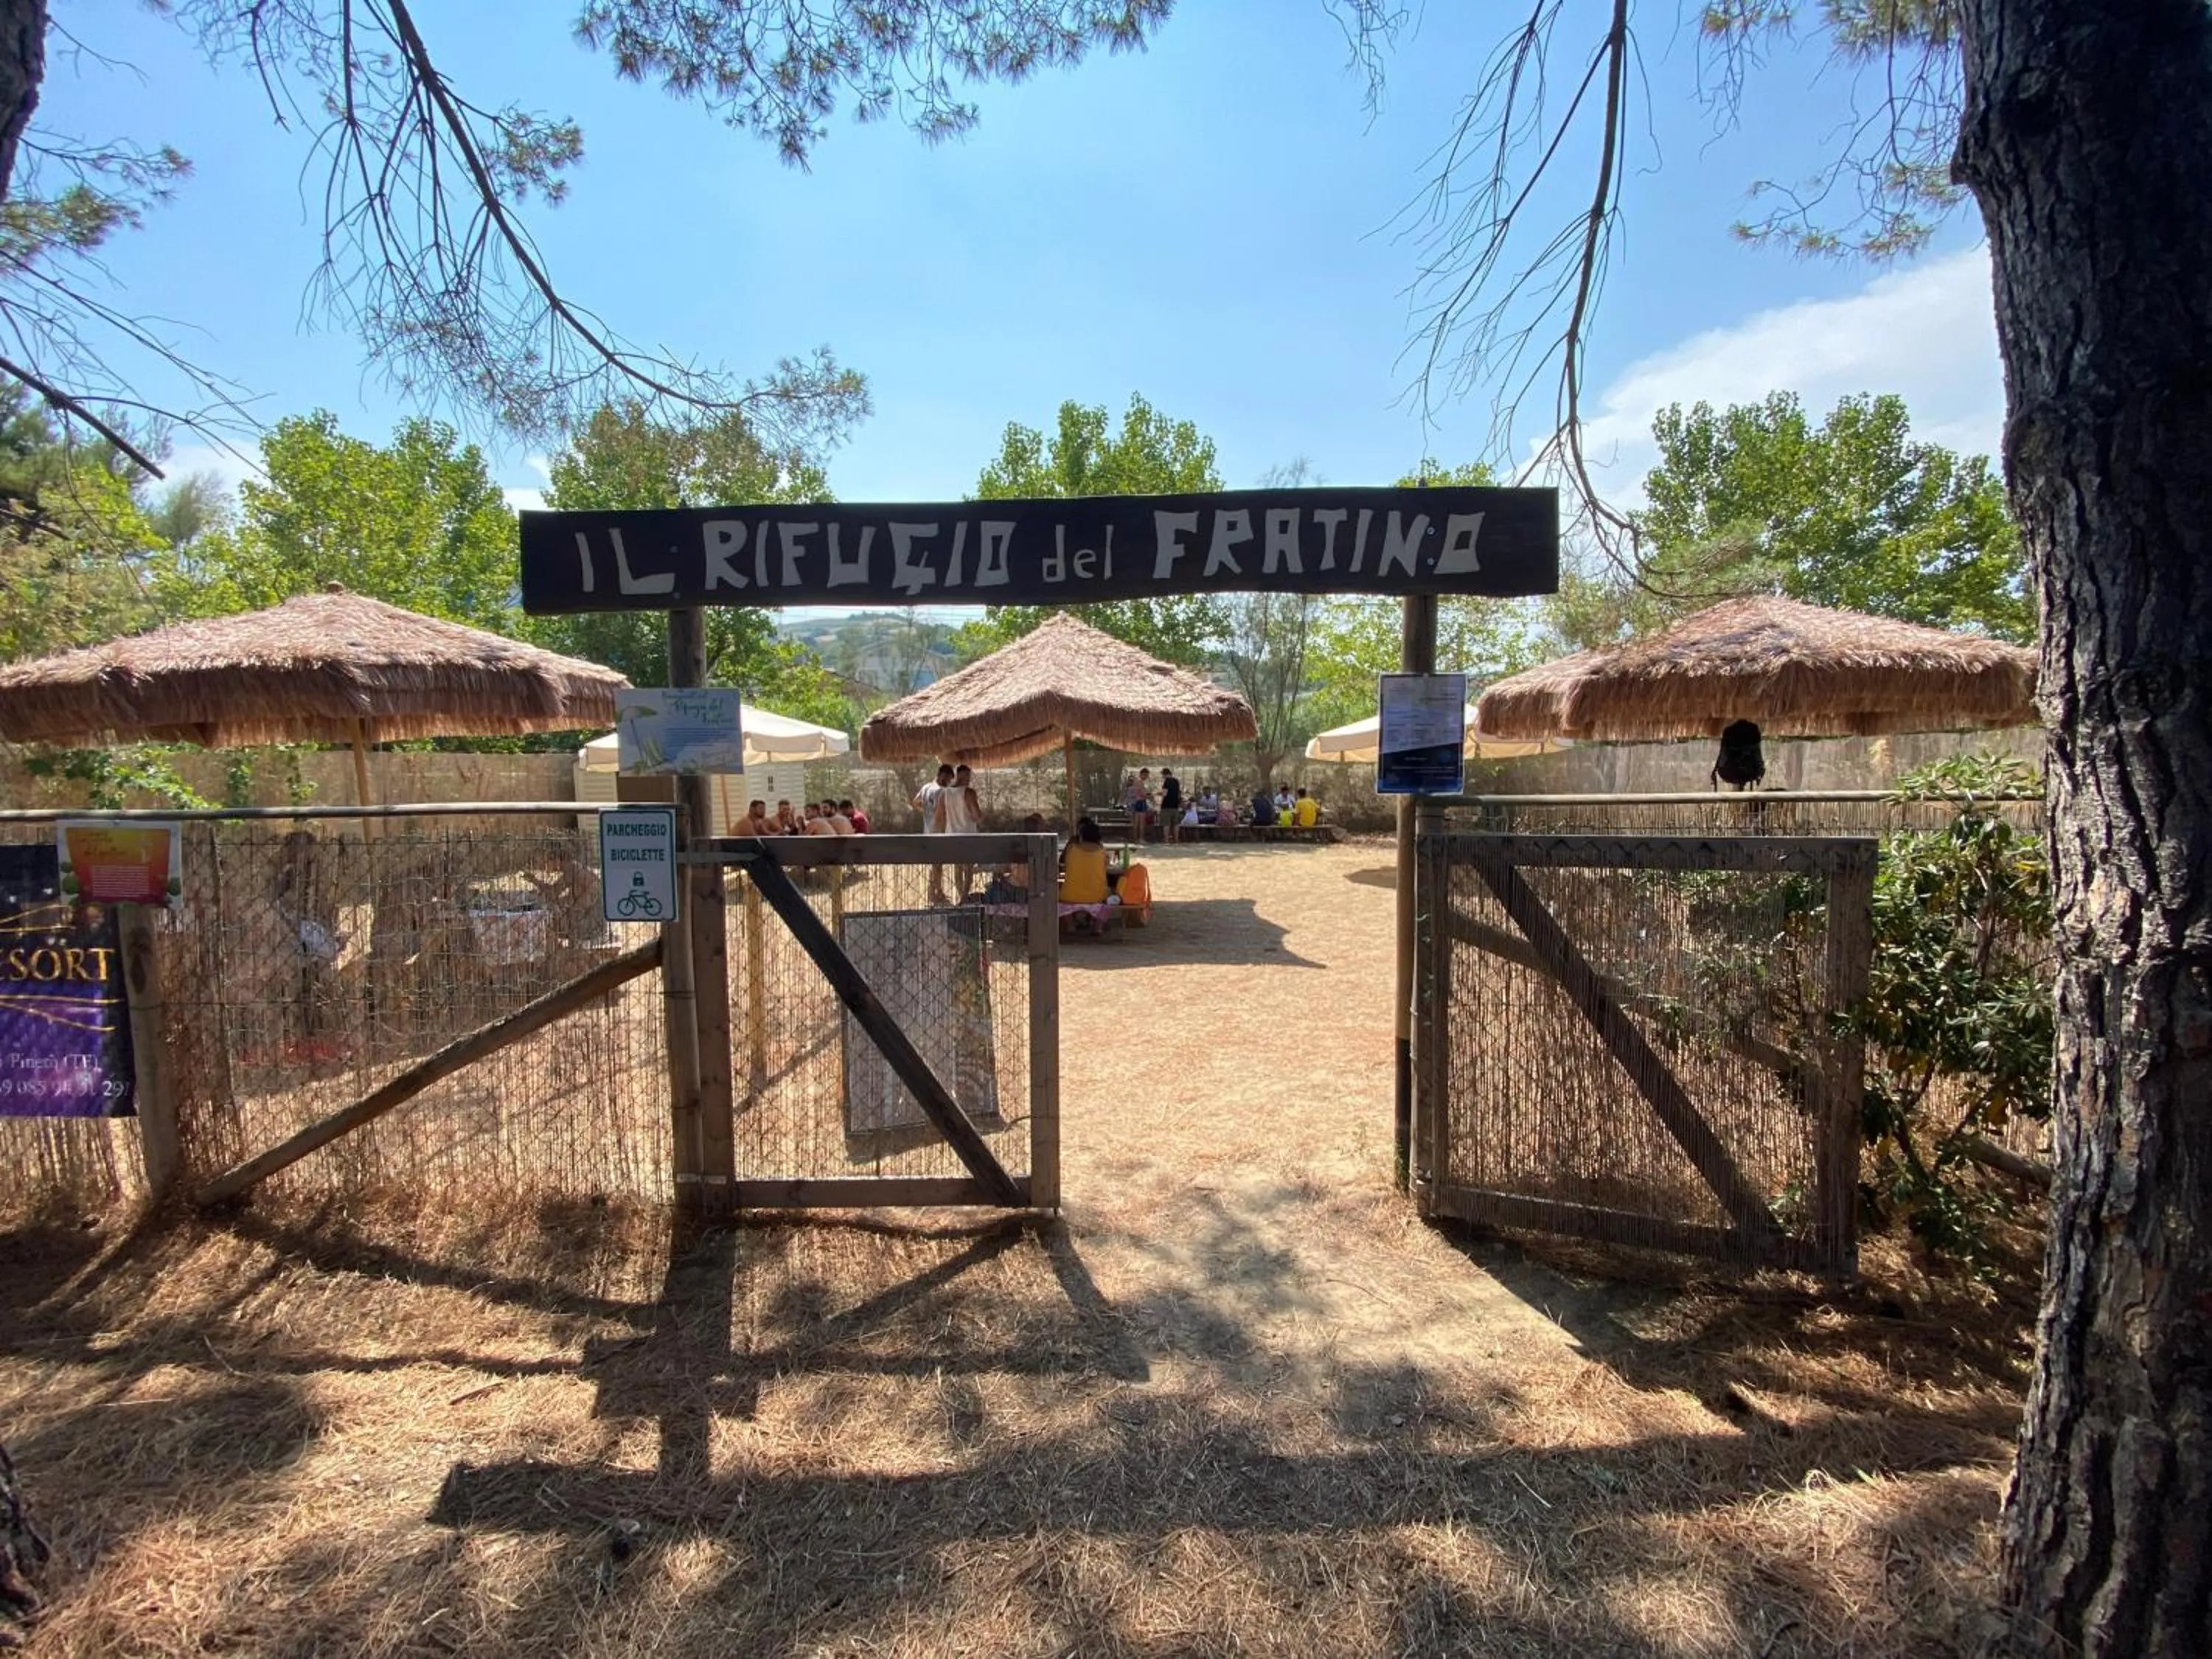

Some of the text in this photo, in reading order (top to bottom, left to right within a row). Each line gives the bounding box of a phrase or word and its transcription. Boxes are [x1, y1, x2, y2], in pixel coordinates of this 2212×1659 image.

[575, 507, 1486, 595] IL RIFUGIO del FRATINO
[607, 824, 667, 836] PARCHEGGIO
[611, 849, 664, 862] BICICLETTE
[0, 947, 116, 981] SORT
